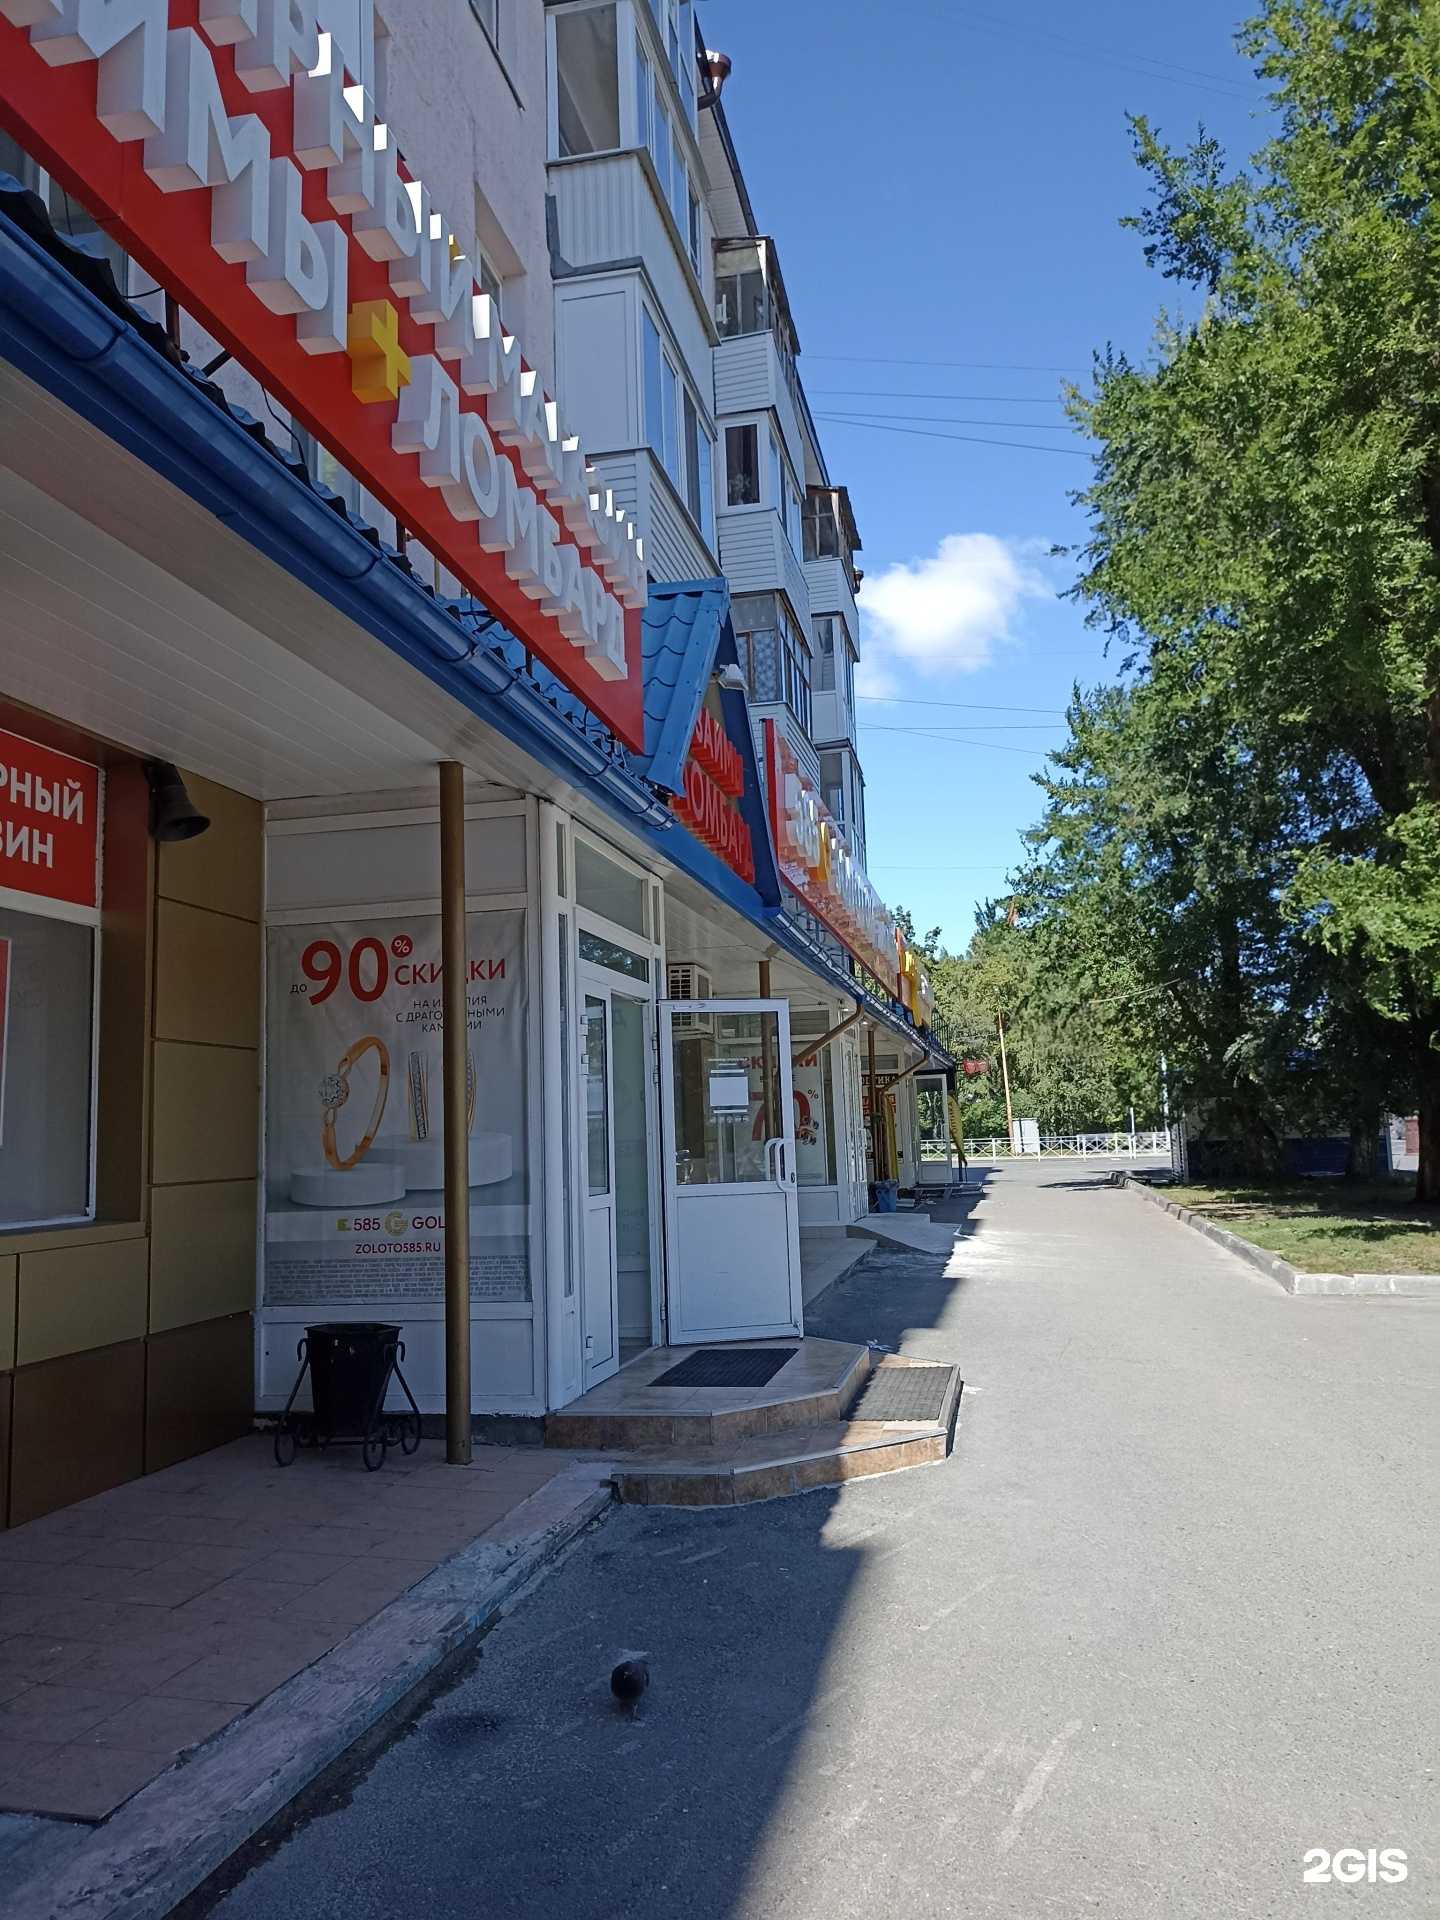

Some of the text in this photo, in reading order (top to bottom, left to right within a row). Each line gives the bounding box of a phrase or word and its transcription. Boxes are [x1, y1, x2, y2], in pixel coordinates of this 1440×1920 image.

[199, 0, 473, 360] РНЫЙ
[391, 354, 628, 682] ЛОМБАРД
[0, 821, 54, 868] ИН
[394, 958, 506, 986] СКИКИ
[406, 1007, 505, 1023] ДРАГОНЫМИ
[355, 1241, 441, 1255] ZOLOTO585.RU
